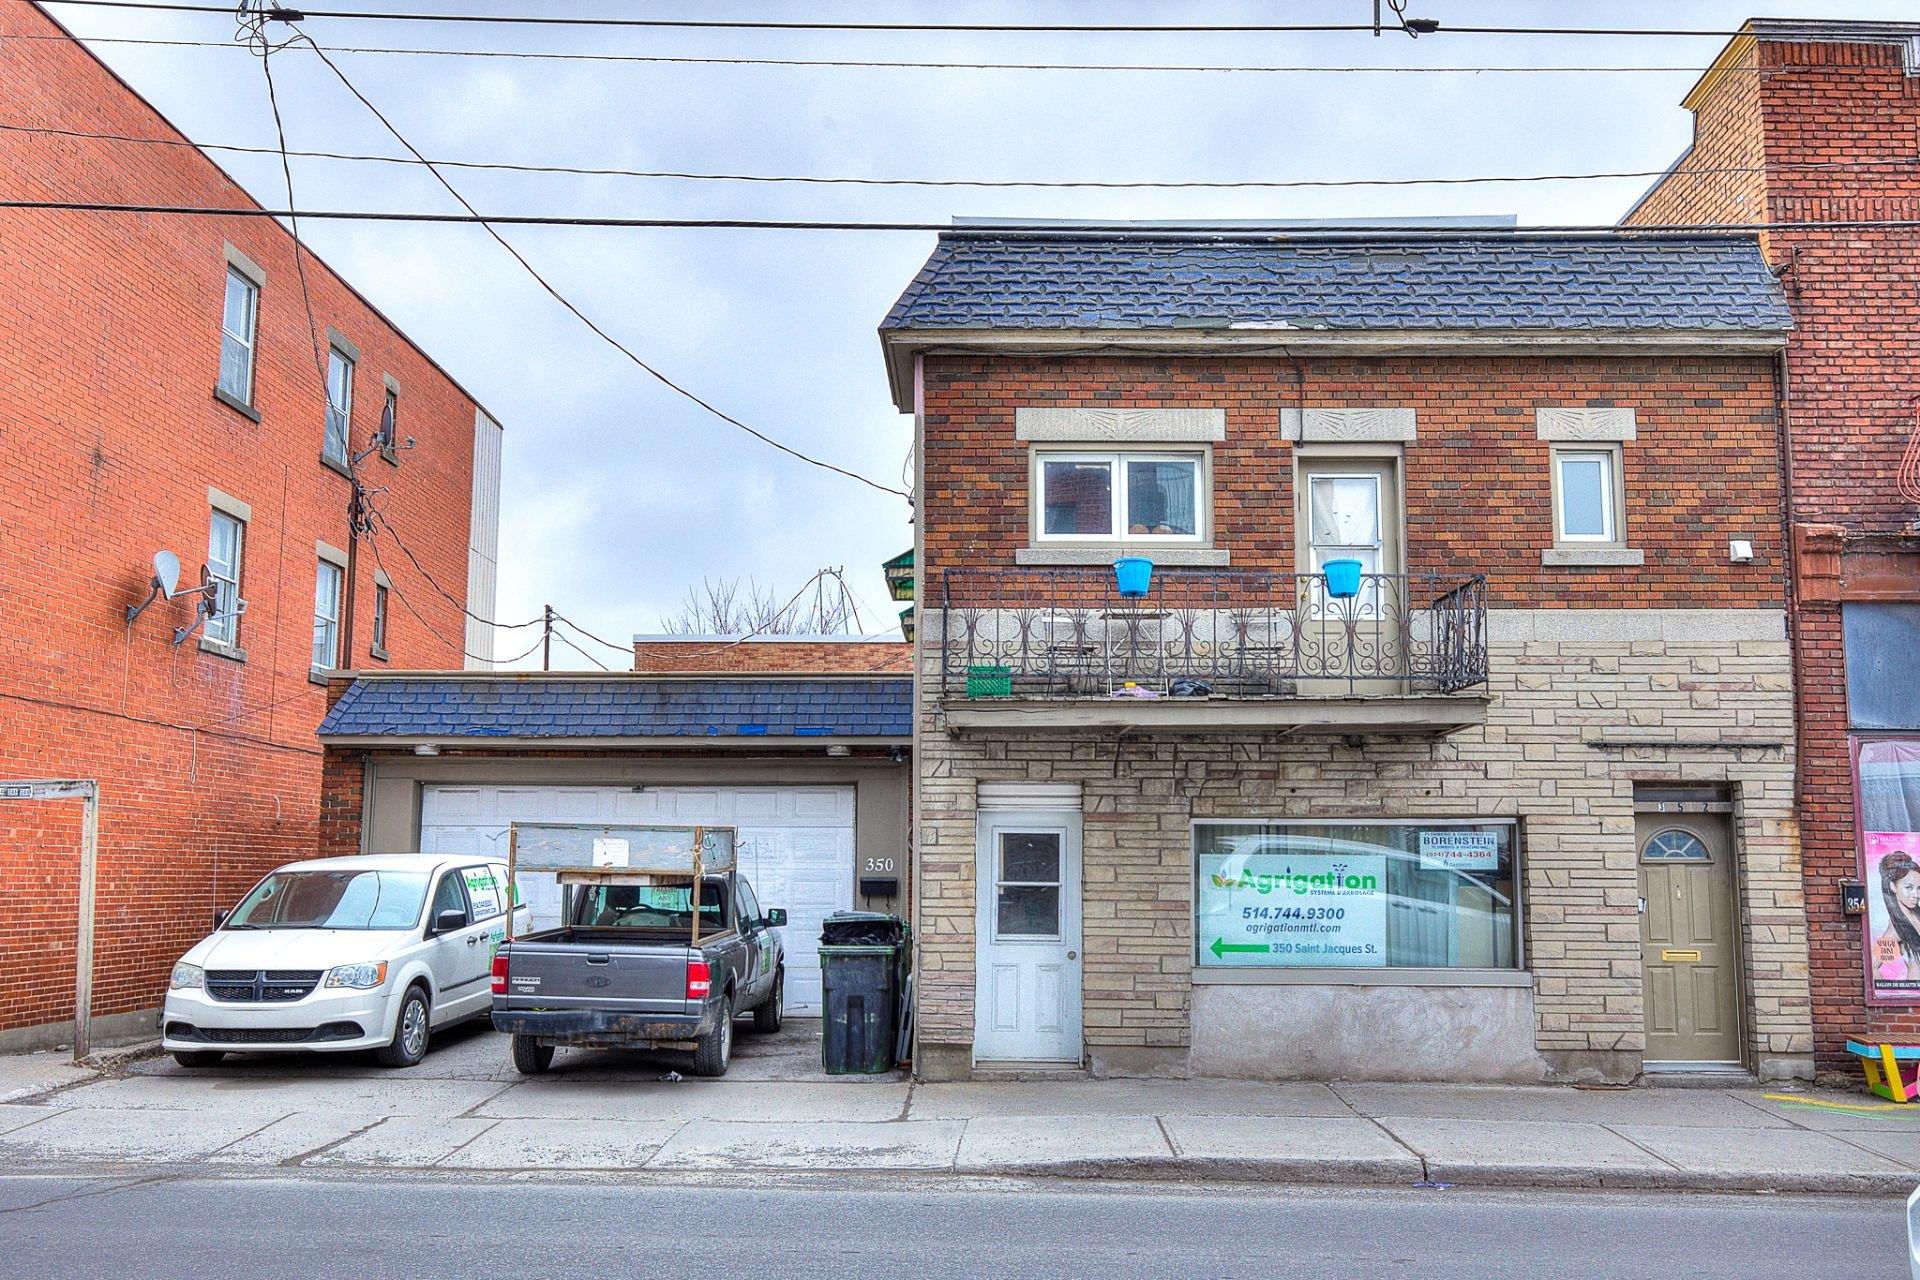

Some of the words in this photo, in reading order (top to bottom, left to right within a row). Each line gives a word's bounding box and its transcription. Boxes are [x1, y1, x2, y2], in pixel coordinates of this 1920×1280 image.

[1423, 836, 1495, 845] BORENSTEIN
[865, 857, 894, 872] 350
[1239, 867, 1377, 895] Agrigation
[1847, 897, 1866, 911] 354
[1242, 907, 1345, 920] 514.744.9300
[1246, 922, 1342, 934] agrigationmtl.com
[1272, 943, 1293, 954] 350
[1295, 943, 1320, 954] Saint
[1322, 943, 1362, 956] Jacques
[1365, 943, 1378, 954] St.
